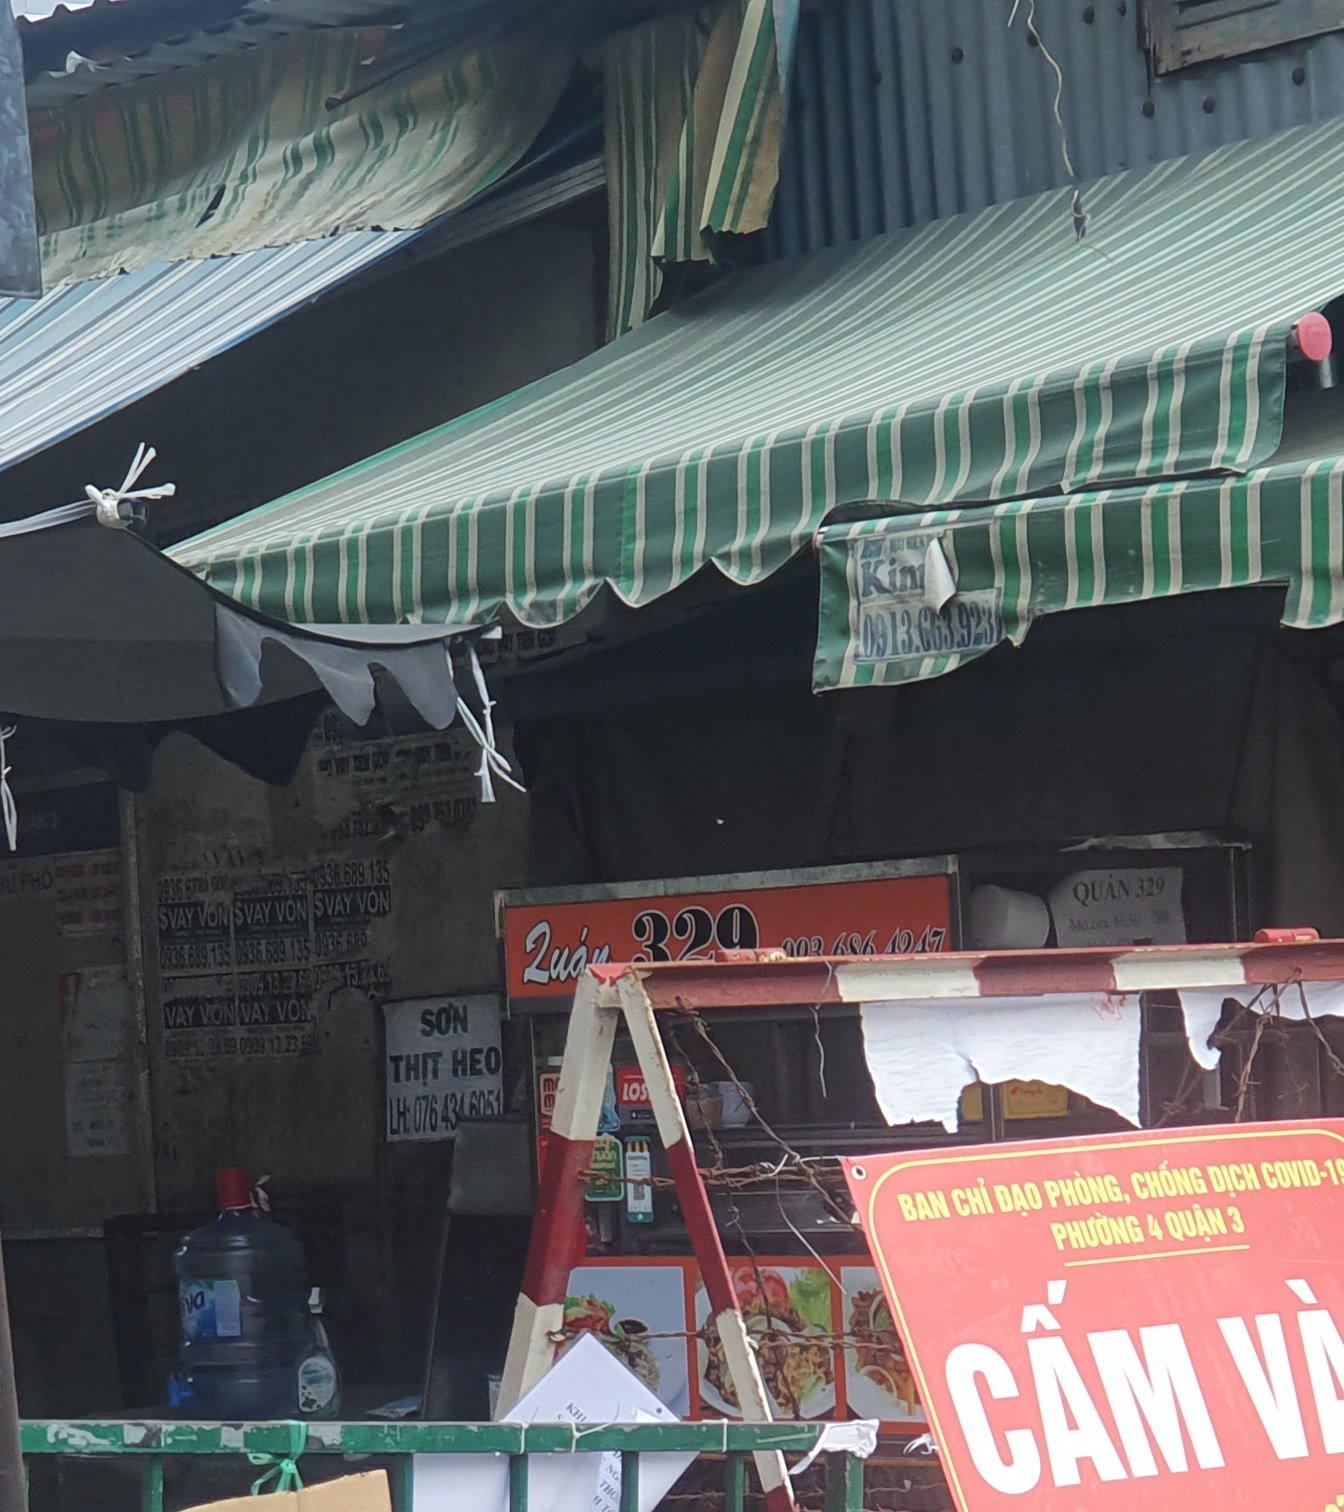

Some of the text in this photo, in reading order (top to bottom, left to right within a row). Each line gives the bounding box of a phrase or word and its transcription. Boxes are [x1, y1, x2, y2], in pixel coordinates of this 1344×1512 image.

[1072, 873, 1165, 907] QUÁN 329
[630, 902, 761, 961] 329
[420, 1001, 469, 1037] SƠN
[389, 1045, 502, 1087] THỊT HEO
[896, 1191, 951, 1222] BAN
[955, 1178, 994, 1217] CHỈ
[994, 1182, 1043, 1217] ĐẠO
[1046, 1170, 1132, 1209] PHÒNG,
[1131, 1160, 1208, 1201] CHỐNG
[1207, 1163, 1257, 1198] DỊCH
[1050, 1204, 1245, 1250] PHƯỜNG 4 QUẬN 3
[945, 1279, 1227, 1495] CẤM
